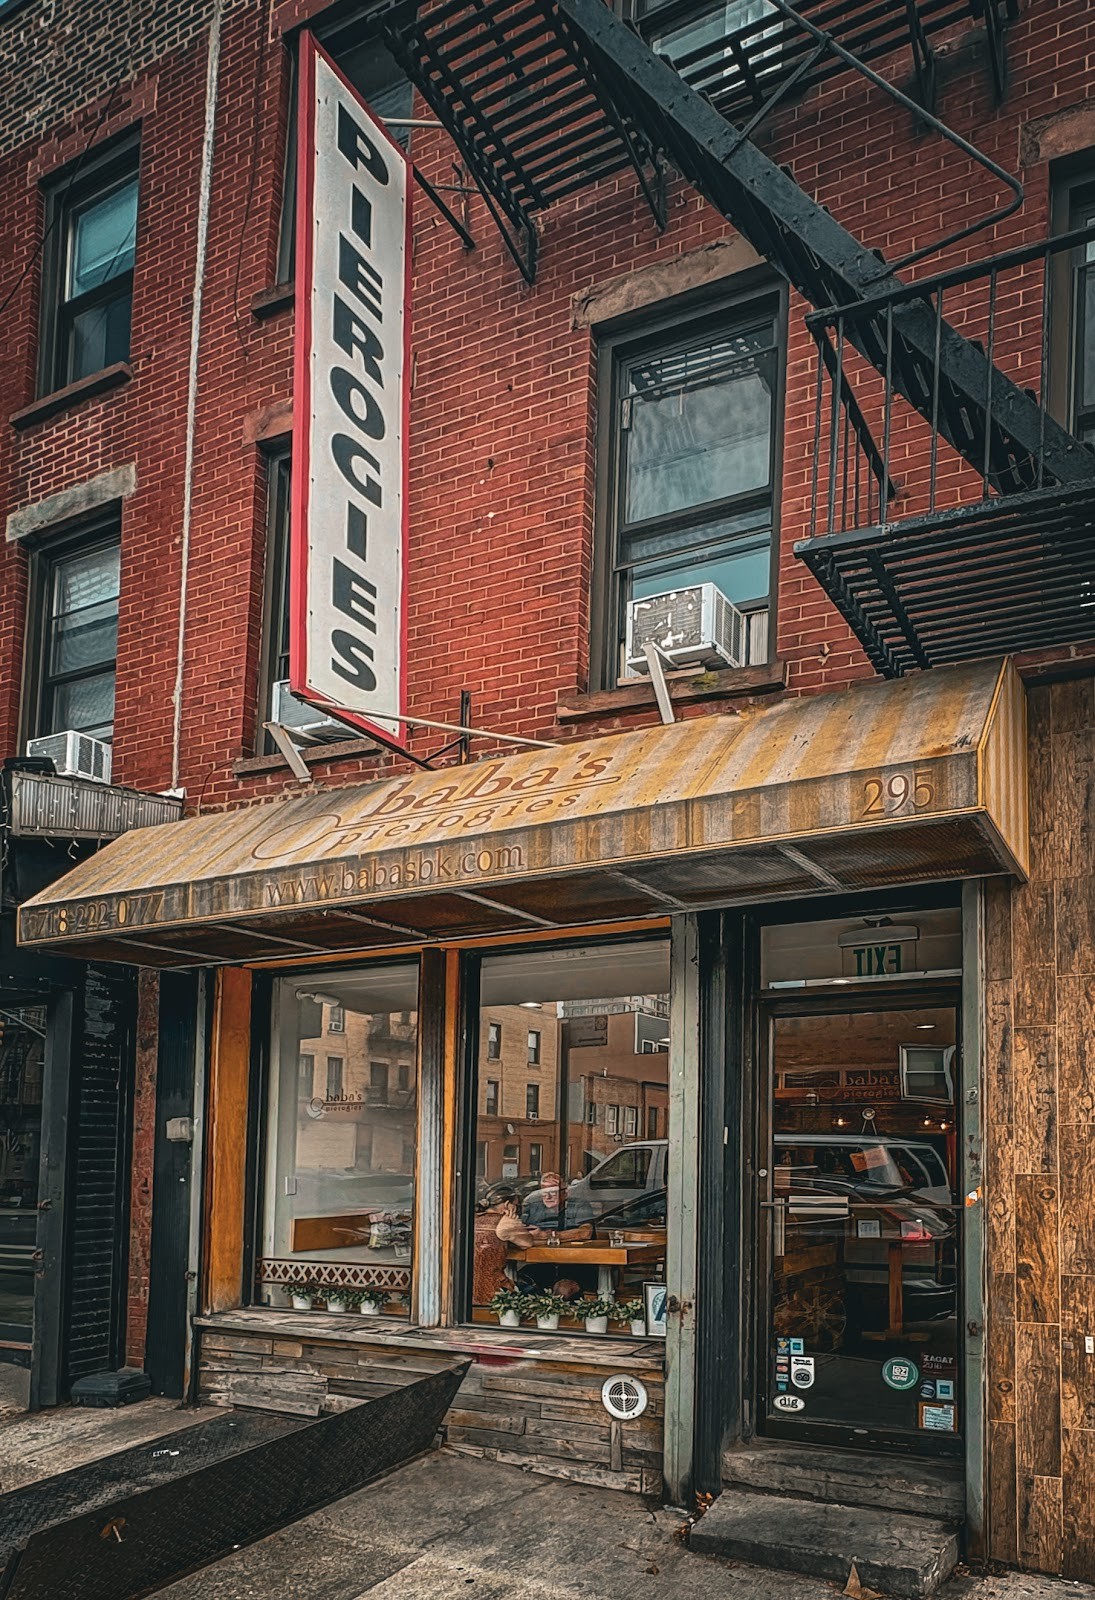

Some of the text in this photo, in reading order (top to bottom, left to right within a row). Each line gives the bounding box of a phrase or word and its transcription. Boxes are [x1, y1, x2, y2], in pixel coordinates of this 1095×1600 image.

[330, 100, 390, 693] PIEROGIES
[360, 752, 614, 819] baba's
[863, 769, 935, 816] 295
[328, 793, 581, 853] pierogies
[266, 844, 525, 902] www.babasbk.com
